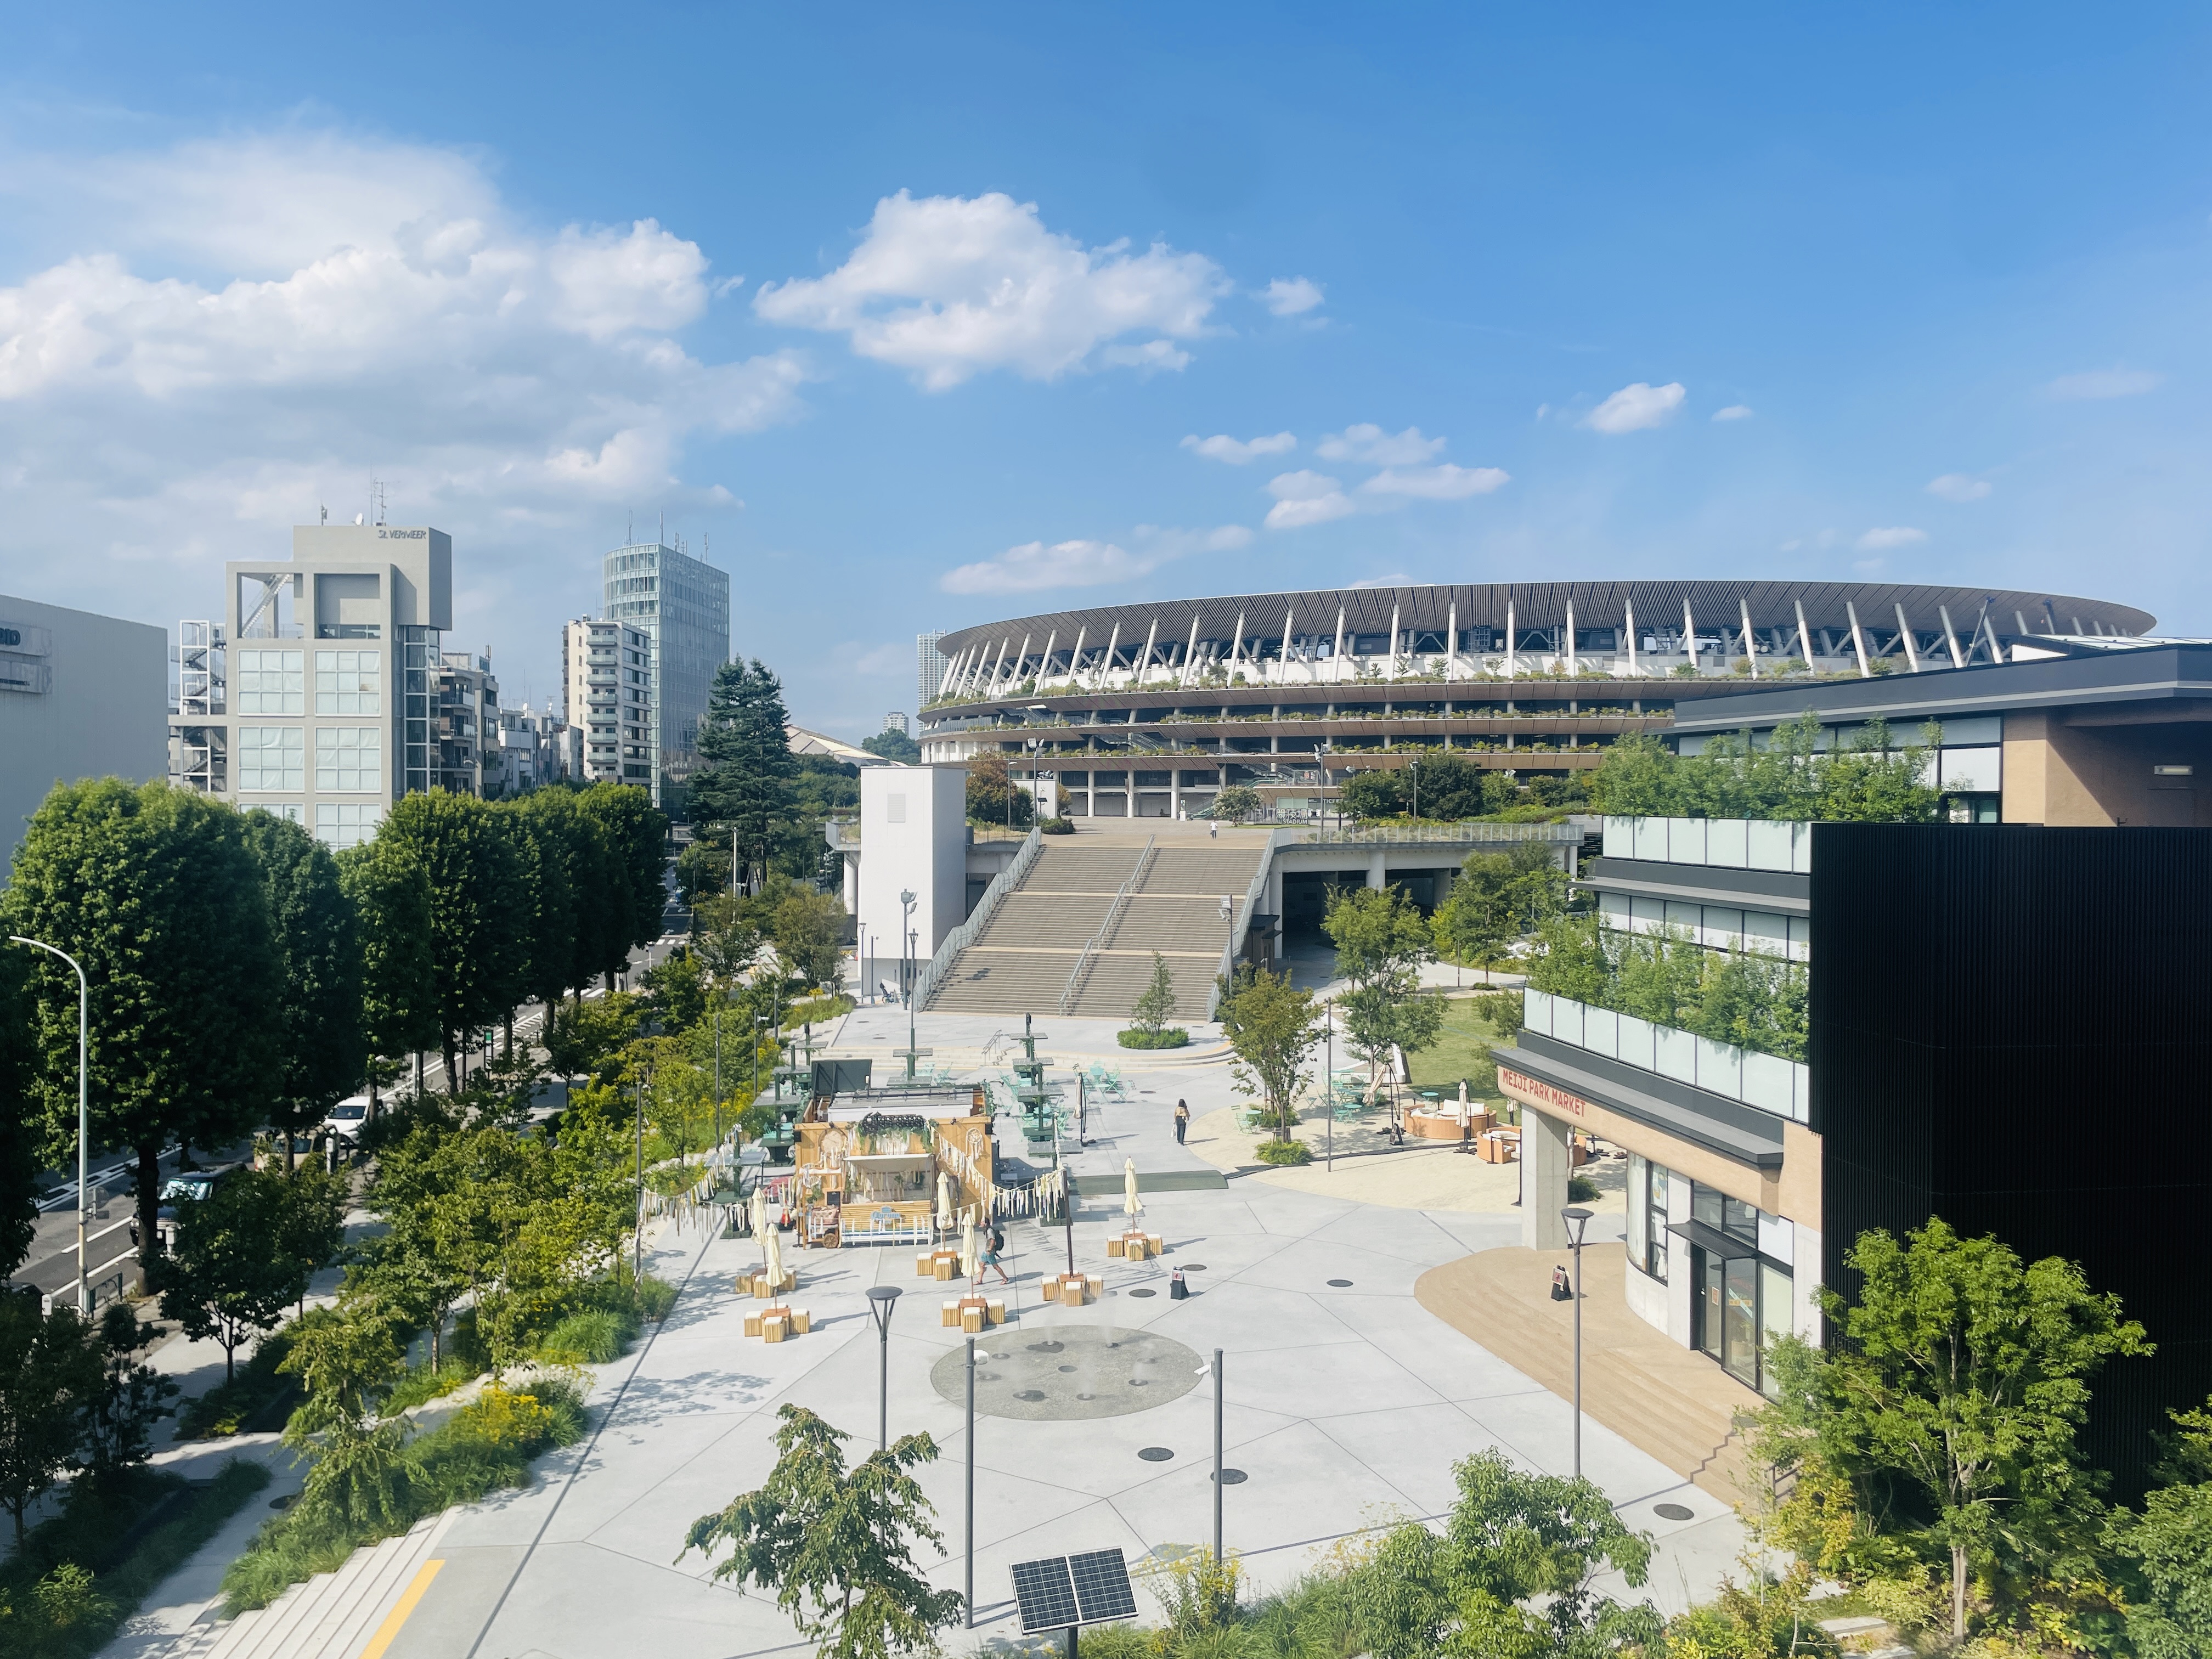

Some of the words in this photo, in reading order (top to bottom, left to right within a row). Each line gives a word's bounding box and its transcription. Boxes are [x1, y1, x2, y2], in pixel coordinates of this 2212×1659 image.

[390, 529, 426, 539] VERMEER
[1503, 1068, 1527, 1092] MEIJI
[1529, 1079, 1550, 1102] PARK
[1552, 1090, 1585, 1117] MARKET
